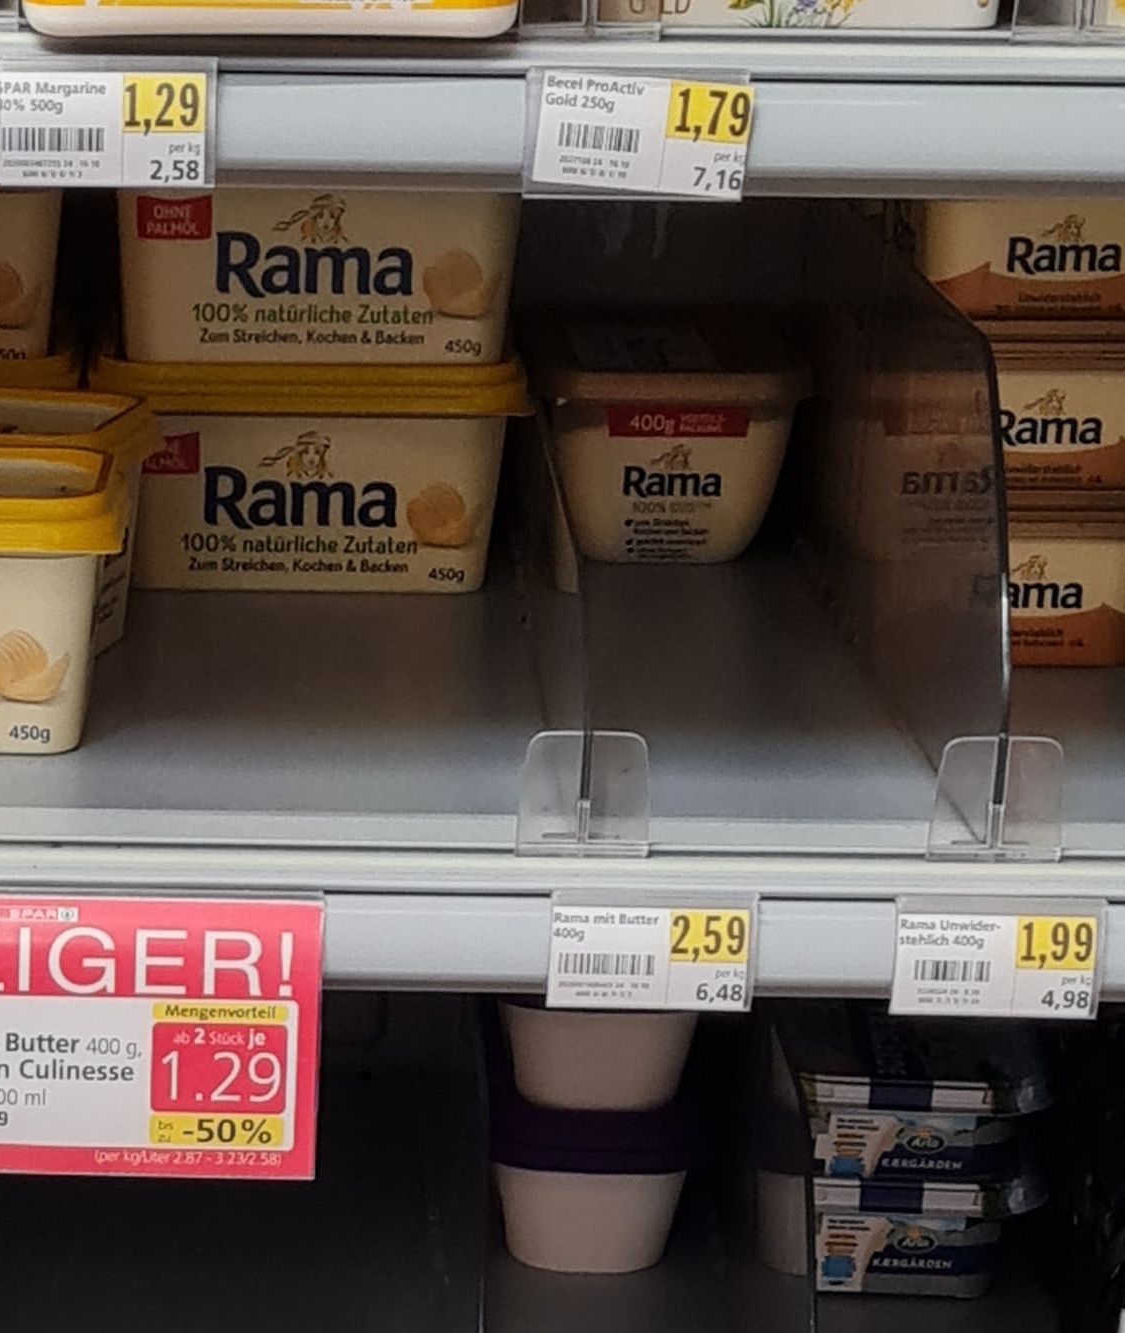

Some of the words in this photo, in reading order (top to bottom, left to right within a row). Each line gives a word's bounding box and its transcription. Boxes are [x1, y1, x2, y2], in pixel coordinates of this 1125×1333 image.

[34, 81, 107, 99] Margarine
[547, 75, 584, 90] Becel
[587, 77, 644, 95] ProActiv
[29, 99, 63, 115] 500g
[123, 83, 199, 135] 1,29
[545, 94, 579, 108] Gold
[582, 94, 616, 113] 250g
[674, 90, 751, 142] 1,79
[150, 160, 200, 184] 2,58
[693, 167, 743, 191] 7,16
[214, 232, 413, 297] Rama
[1007, 237, 1122, 272] Rama
[191, 304, 248, 323] 100%
[255, 304, 352, 325] natürliche
[357, 306, 434, 326] Zutaten
[630, 413, 676, 434] 400g
[622, 466, 722, 497] Rama
[203, 466, 398, 528] Rama
[8, 724, 51, 744] 450g
[553, 912, 590, 925] Rama
[594, 913, 614, 926] mit
[618, 914, 659, 927] Butter
[900, 920, 936, 931] Rama
[553, 927, 585, 941] 400g
[671, 916, 746, 963] 2,59
[899, 934, 950, 948] stehlich
[952, 934, 985, 950] 400g
[1021, 923, 1094, 970] 1,99
[695, 983, 743, 1002] 6,48
[1041, 991, 1090, 1010] 4,98
[165, 1004, 277, 1021] Mengenvorteil
[5, 1034, 79, 1055] Butter
[86, 1037, 121, 1056] 400
[125, 1042, 143, 1058] g,
[19, 1060, 134, 1083] Culinesse
[159, 1051, 282, 1103] 1.29
[24, 1088, 47, 1107] ml
[182, 1119, 272, 1143] -50%
